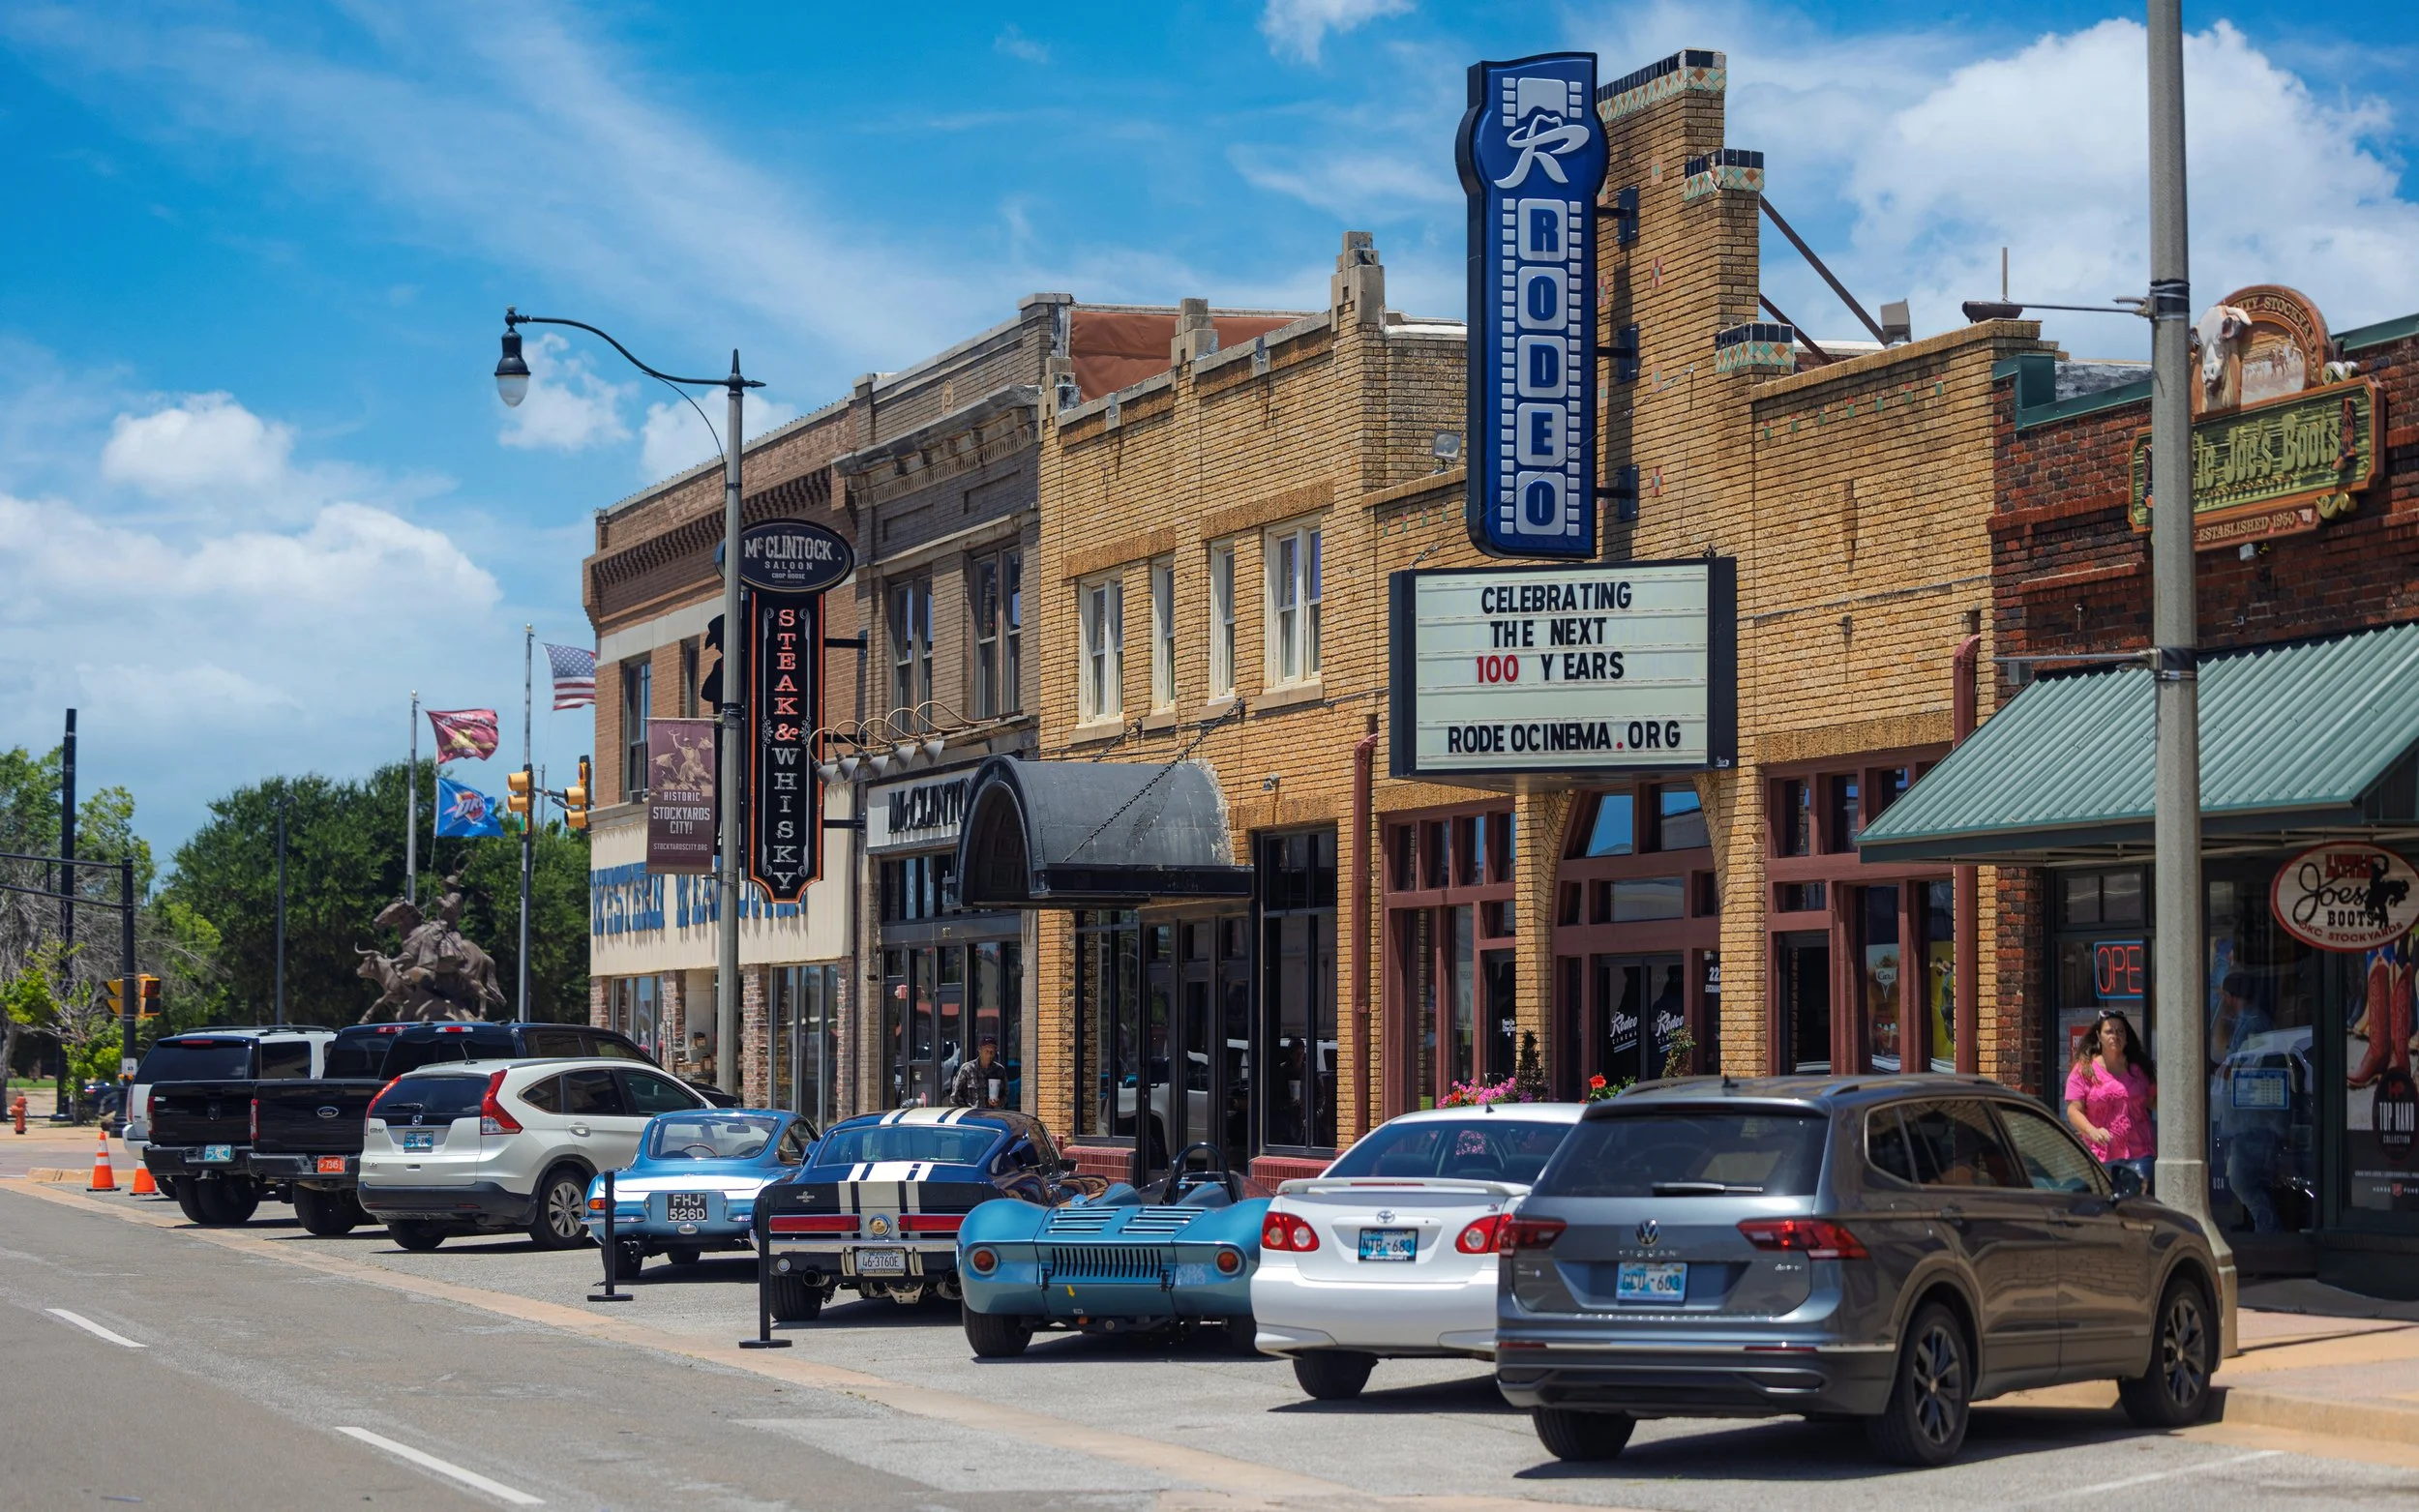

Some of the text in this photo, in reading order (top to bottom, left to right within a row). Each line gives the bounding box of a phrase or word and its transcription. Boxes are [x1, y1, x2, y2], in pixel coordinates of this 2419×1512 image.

[1525, 208, 1559, 527] RODEO
[2225, 419, 2274, 485] Joe's
[2282, 412, 2340, 472] Boots
[2198, 511, 2296, 542] ESTABLISHED 1950
[764, 561, 813, 570] SALOON
[1481, 581, 1632, 614] CELEBRATING
[1490, 617, 1606, 648] THE NEXT
[774, 608, 798, 715] STEAK
[1477, 654, 1519, 684] 100
[774, 723, 799, 742] &
[663, 791, 701, 802] HISTORIC
[652, 806, 710, 820] STOCKYARDS
[771, 748, 800, 890] WHISKY
[670, 820, 693, 834] CITY!
[653, 843, 708, 851] STOCKYARDSCITY.ORG
[590, 862, 665, 936] WESTERN
[2292, 862, 2370, 925] Joes
[2327, 909, 2376, 927] BOOTS
[2298, 920, 2404, 942] OKC STOCKYARDS
[1709, 966, 1720, 982] 22
[2098, 946, 2143, 993] OPE
[1610, 1011, 1637, 1038] Rodeo
[1656, 1010, 1684, 1037] Rodeo
[1612, 1030, 1637, 1045] CINEMA
[2379, 1102, 2414, 1132] TOP HAND
[2383, 1135, 2410, 1143] COLLECTION
[2213, 1177, 2224, 1189] USA
[672, 1195, 701, 1206] FHJ
[669, 1209, 706, 1221] 526D
